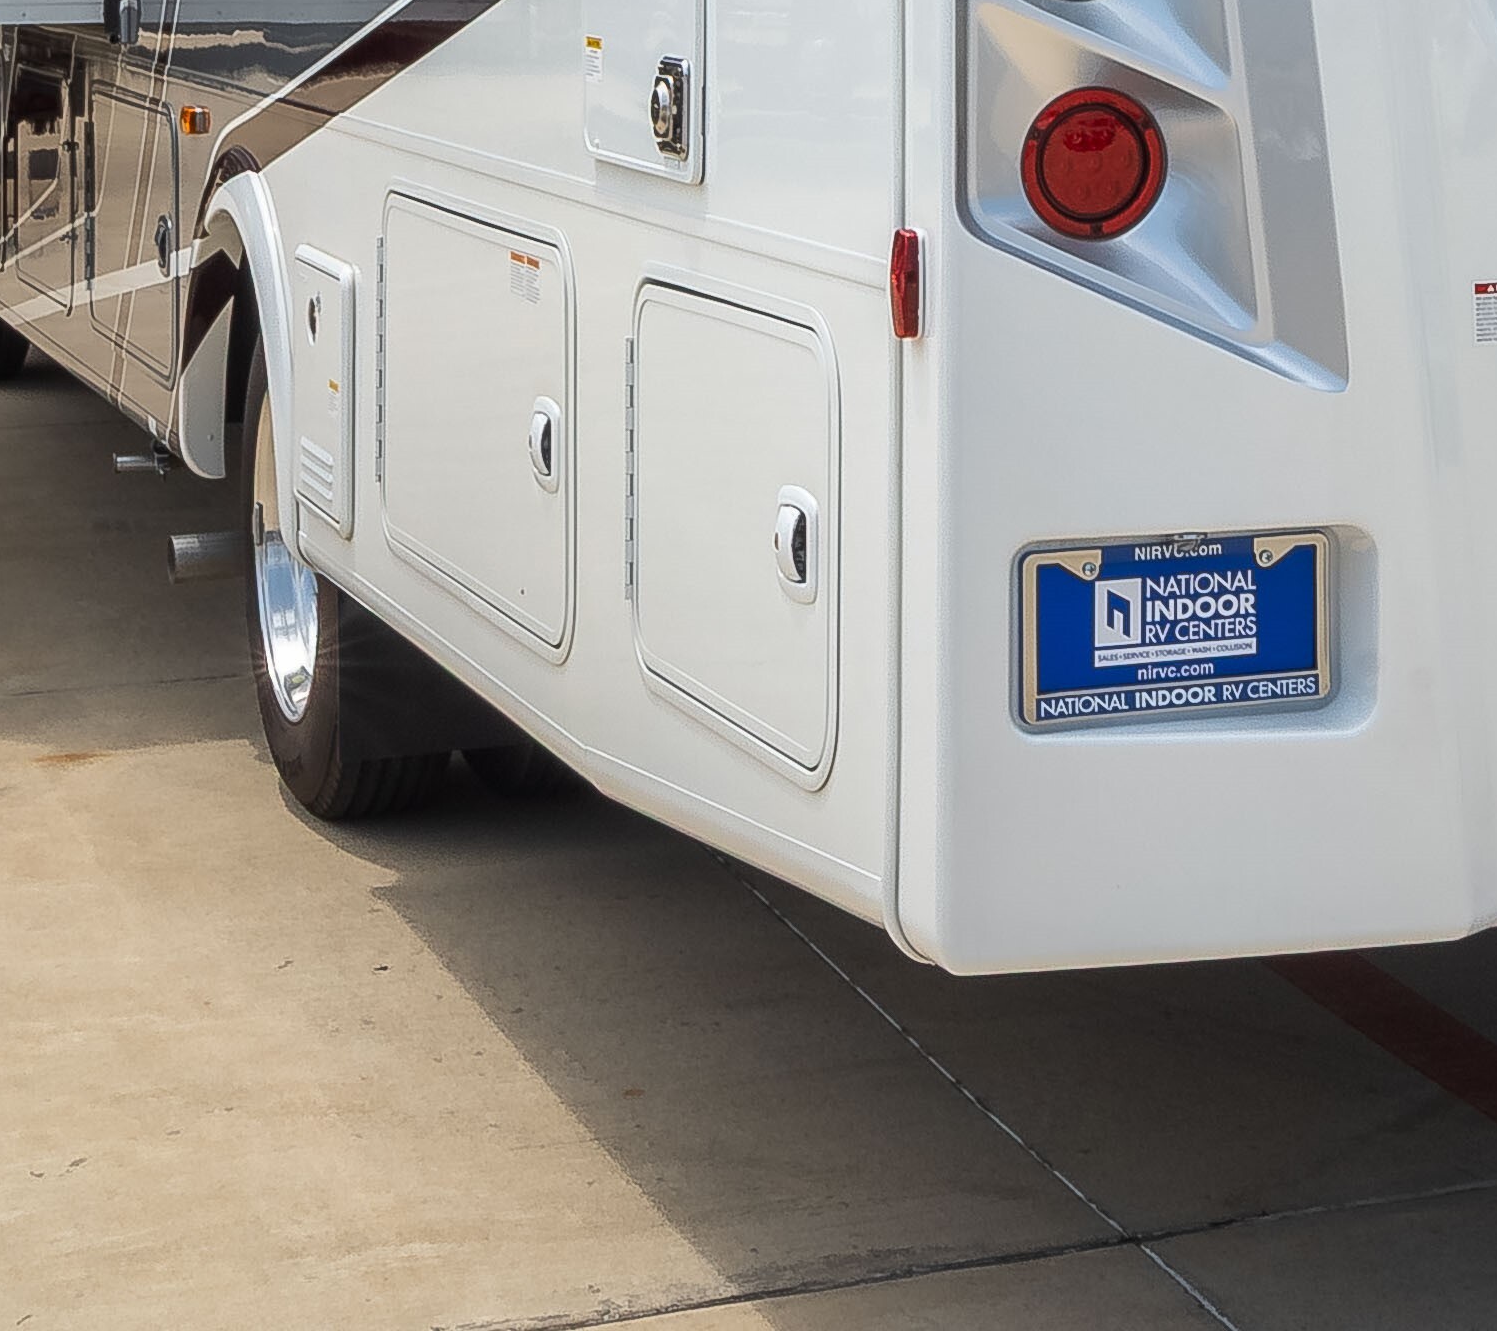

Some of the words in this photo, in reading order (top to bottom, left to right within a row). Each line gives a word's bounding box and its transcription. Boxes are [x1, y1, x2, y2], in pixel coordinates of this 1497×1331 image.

[1146, 570, 1256, 598] NATIONAL
[1146, 593, 1256, 622] INDOOR
[1145, 622, 1170, 644] RV
[1175, 616, 1257, 641] CENTERS
[1137, 662, 1214, 681] nirvc.com
[1040, 692, 1129, 718] NATIONAL
[1135, 687, 1217, 710] INDOOR
[1222, 683, 1244, 701] RV
[1247, 677, 1316, 698] CENTERS
